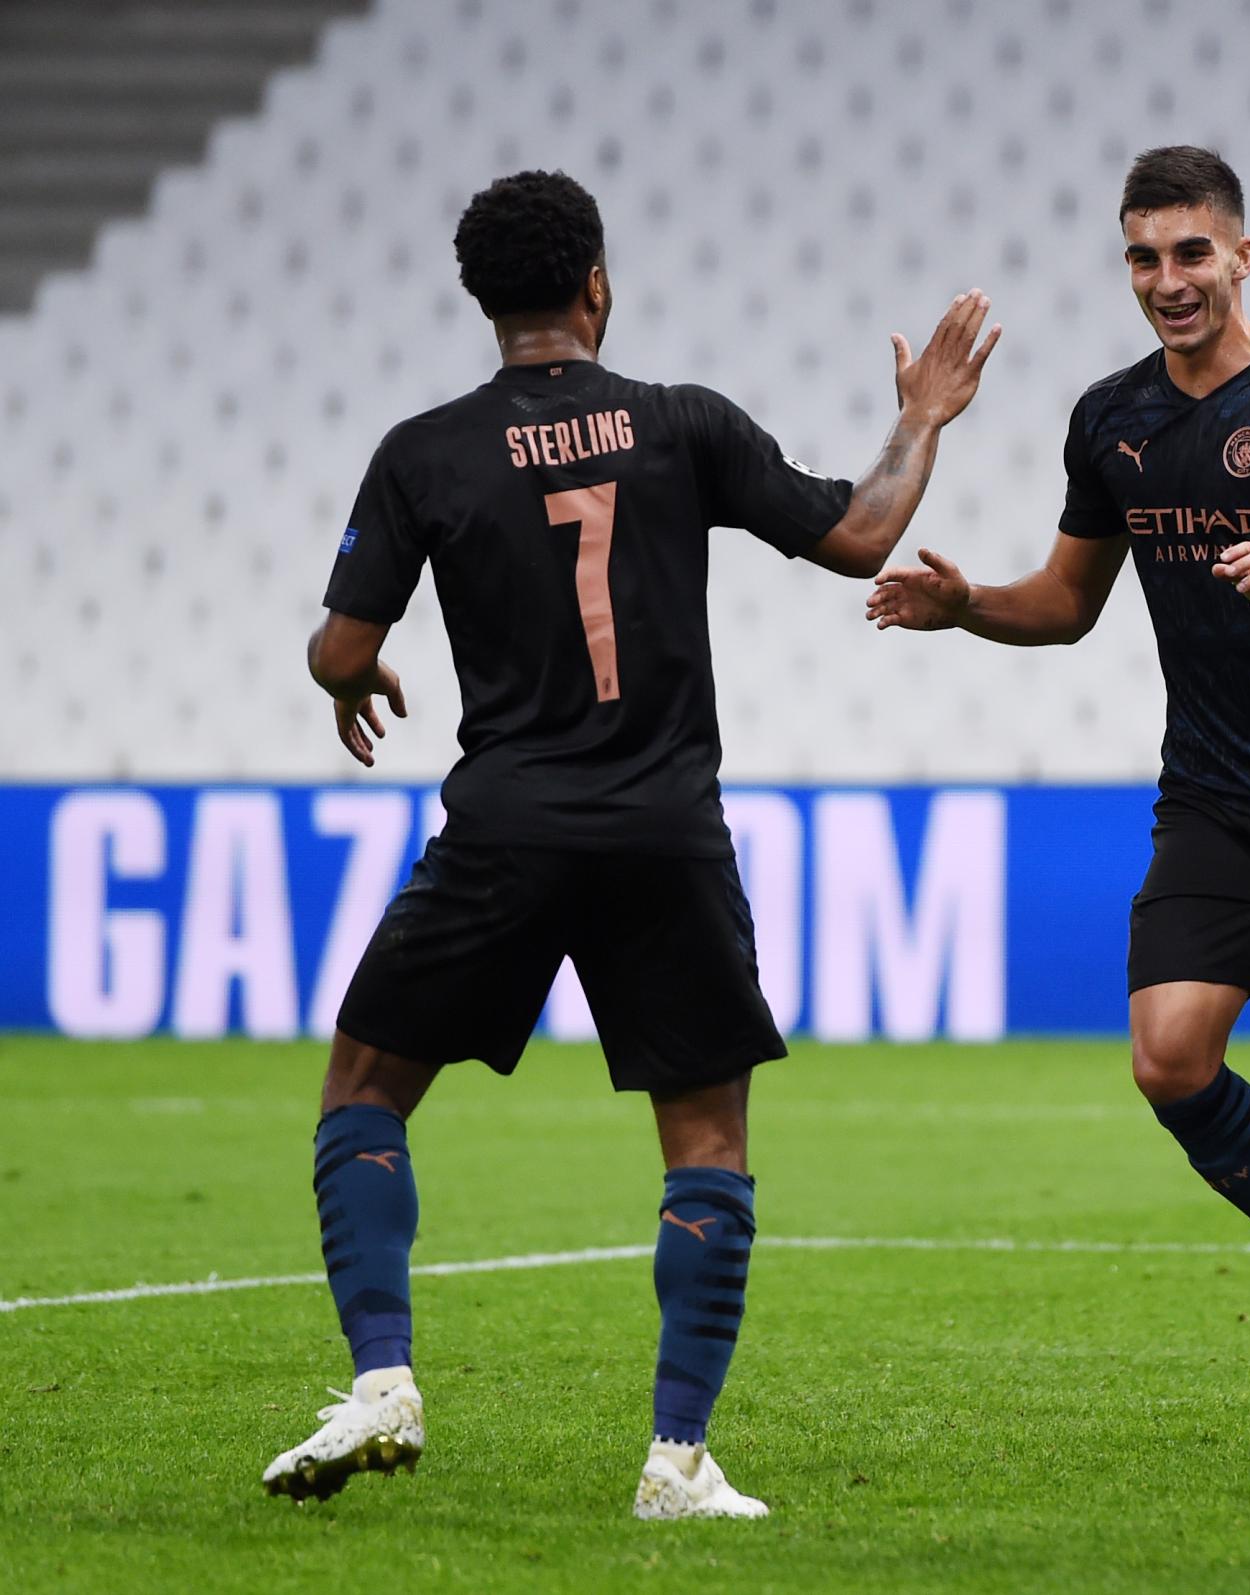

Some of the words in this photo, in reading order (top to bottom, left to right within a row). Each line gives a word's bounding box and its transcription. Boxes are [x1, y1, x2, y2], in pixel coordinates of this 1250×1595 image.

[505, 409, 634, 468] STERLING
[544, 481, 620, 702] 7
[48, 790, 1007, 1042] GAZOM
